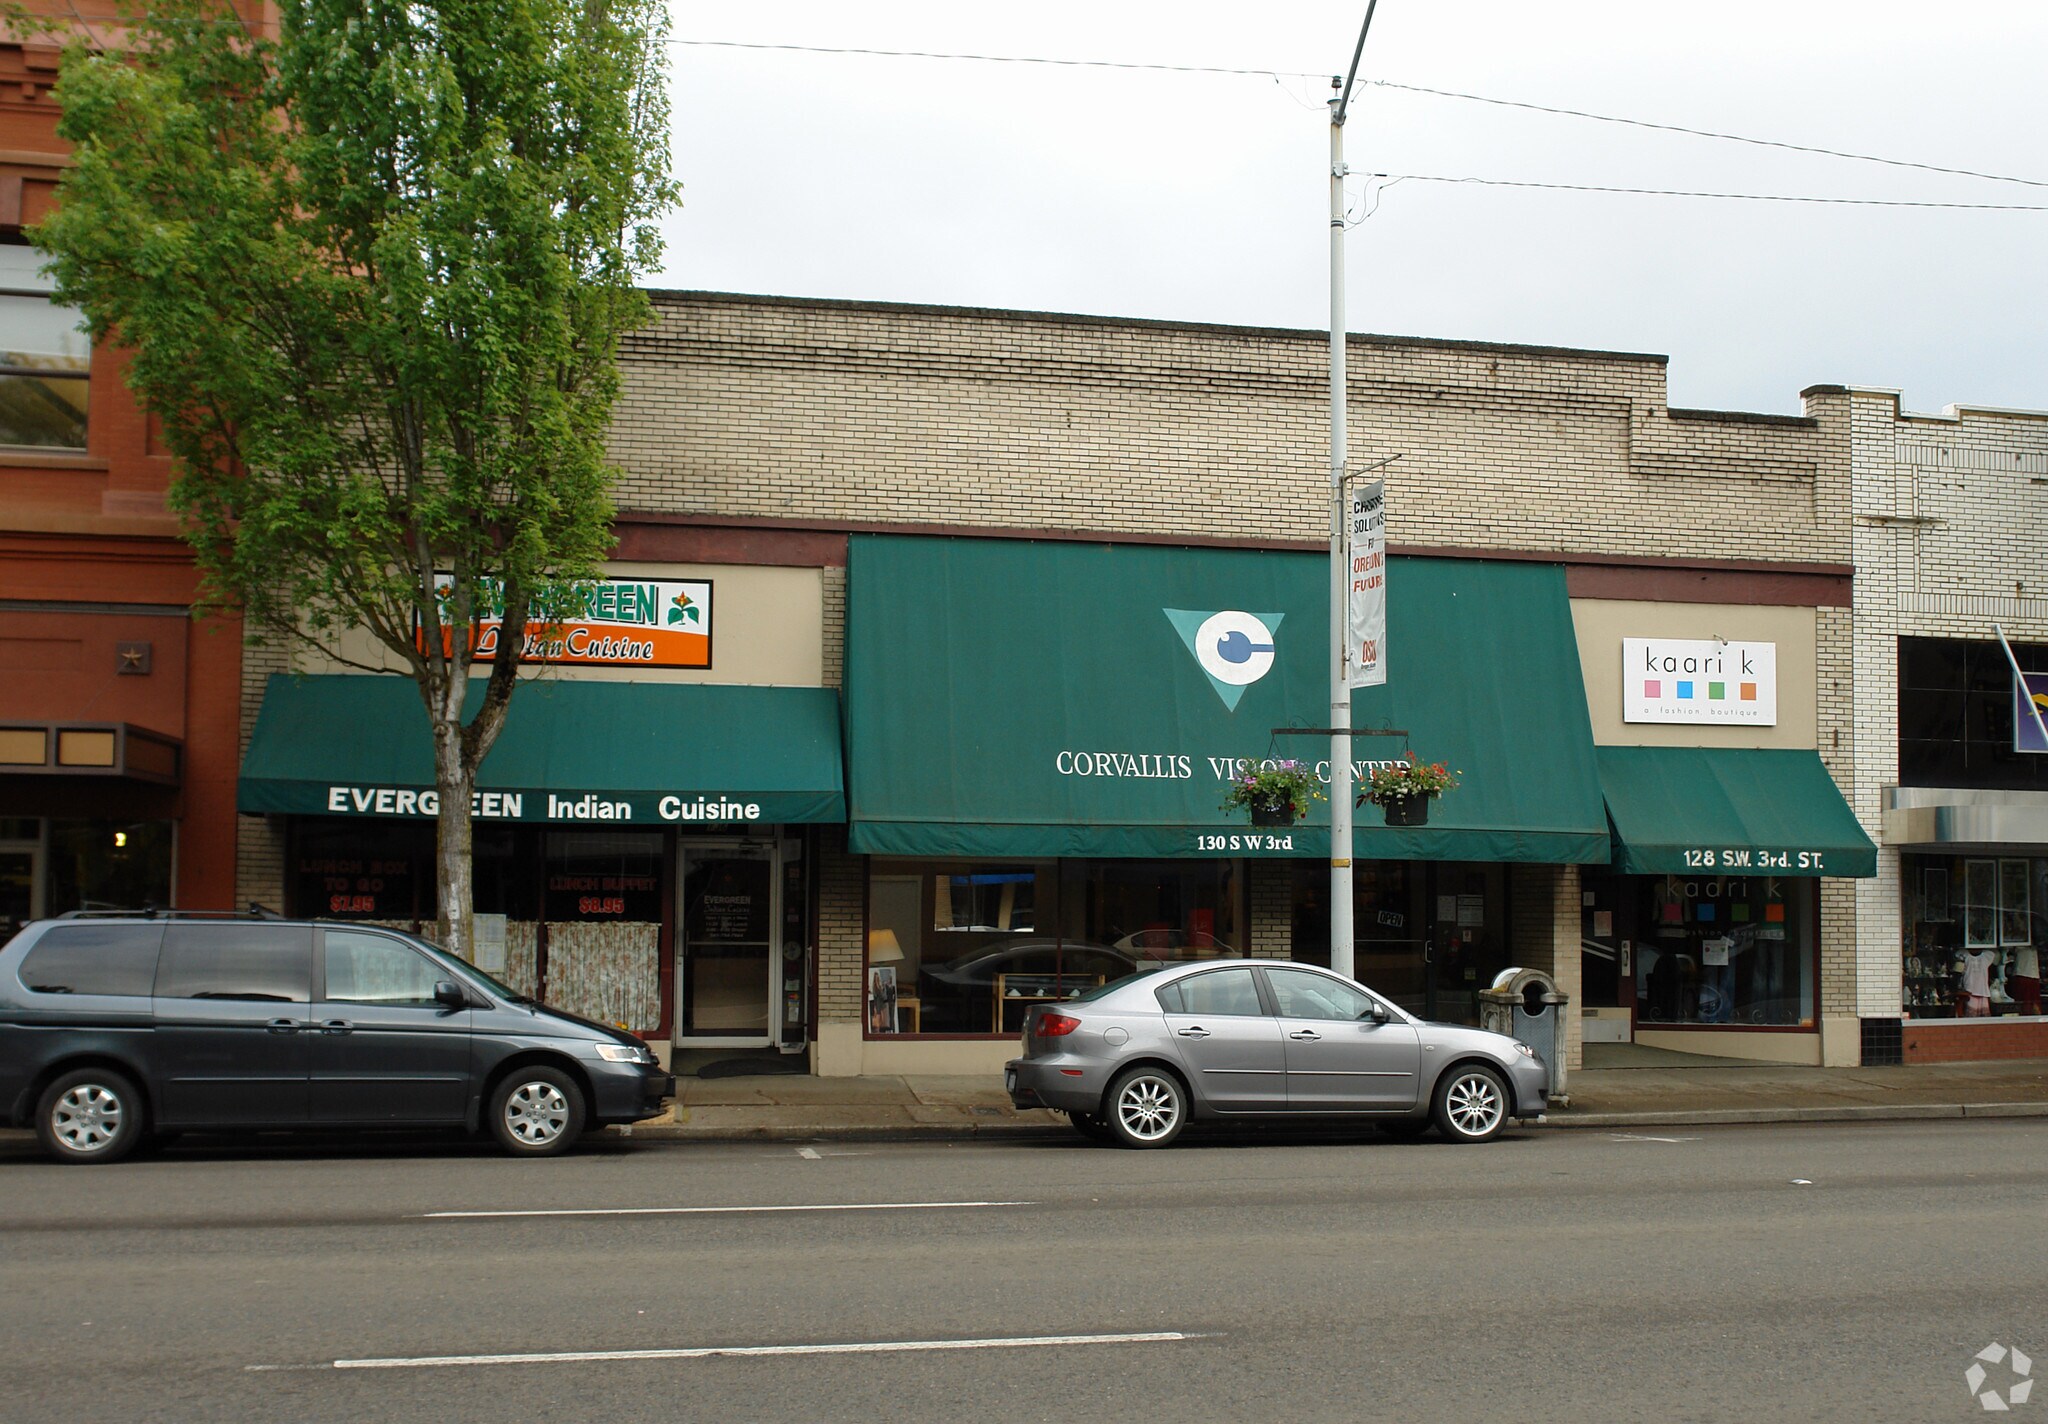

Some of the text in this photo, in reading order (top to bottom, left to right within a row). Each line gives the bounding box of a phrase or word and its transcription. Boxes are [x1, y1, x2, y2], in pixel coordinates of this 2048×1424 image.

[1354, 511, 1384, 534] SOLUTS
[1353, 550, 1384, 574] OREONS
[1353, 575, 1383, 593] FUUR
[470, 579, 659, 626] EVRREEN
[476, 625, 654, 660] Iian Cuisine
[1646, 646, 1754, 675] kaari k
[1660, 706, 1700, 715] fashion
[1711, 708, 1758, 717] boutique
[1056, 751, 1413, 784] CORVALLIS VISO CNTR
[327, 786, 761, 820] EVERGEN Indian Cuisine
[1197, 835, 1294, 850] 130 S W 3rd
[299, 859, 361, 874] LUNCH
[1683, 850, 1824, 869] 128 S.W. 3rd. ST.
[322, 877, 350, 893] TO
[549, 877, 600, 892] LUNCH
[1666, 874, 1782, 898] kaari k
[330, 895, 375, 912] $7.95
[579, 897, 625, 914] $8.95
[704, 895, 751, 905] EVERGREEN
[1379, 911, 1403, 926] OPEN
